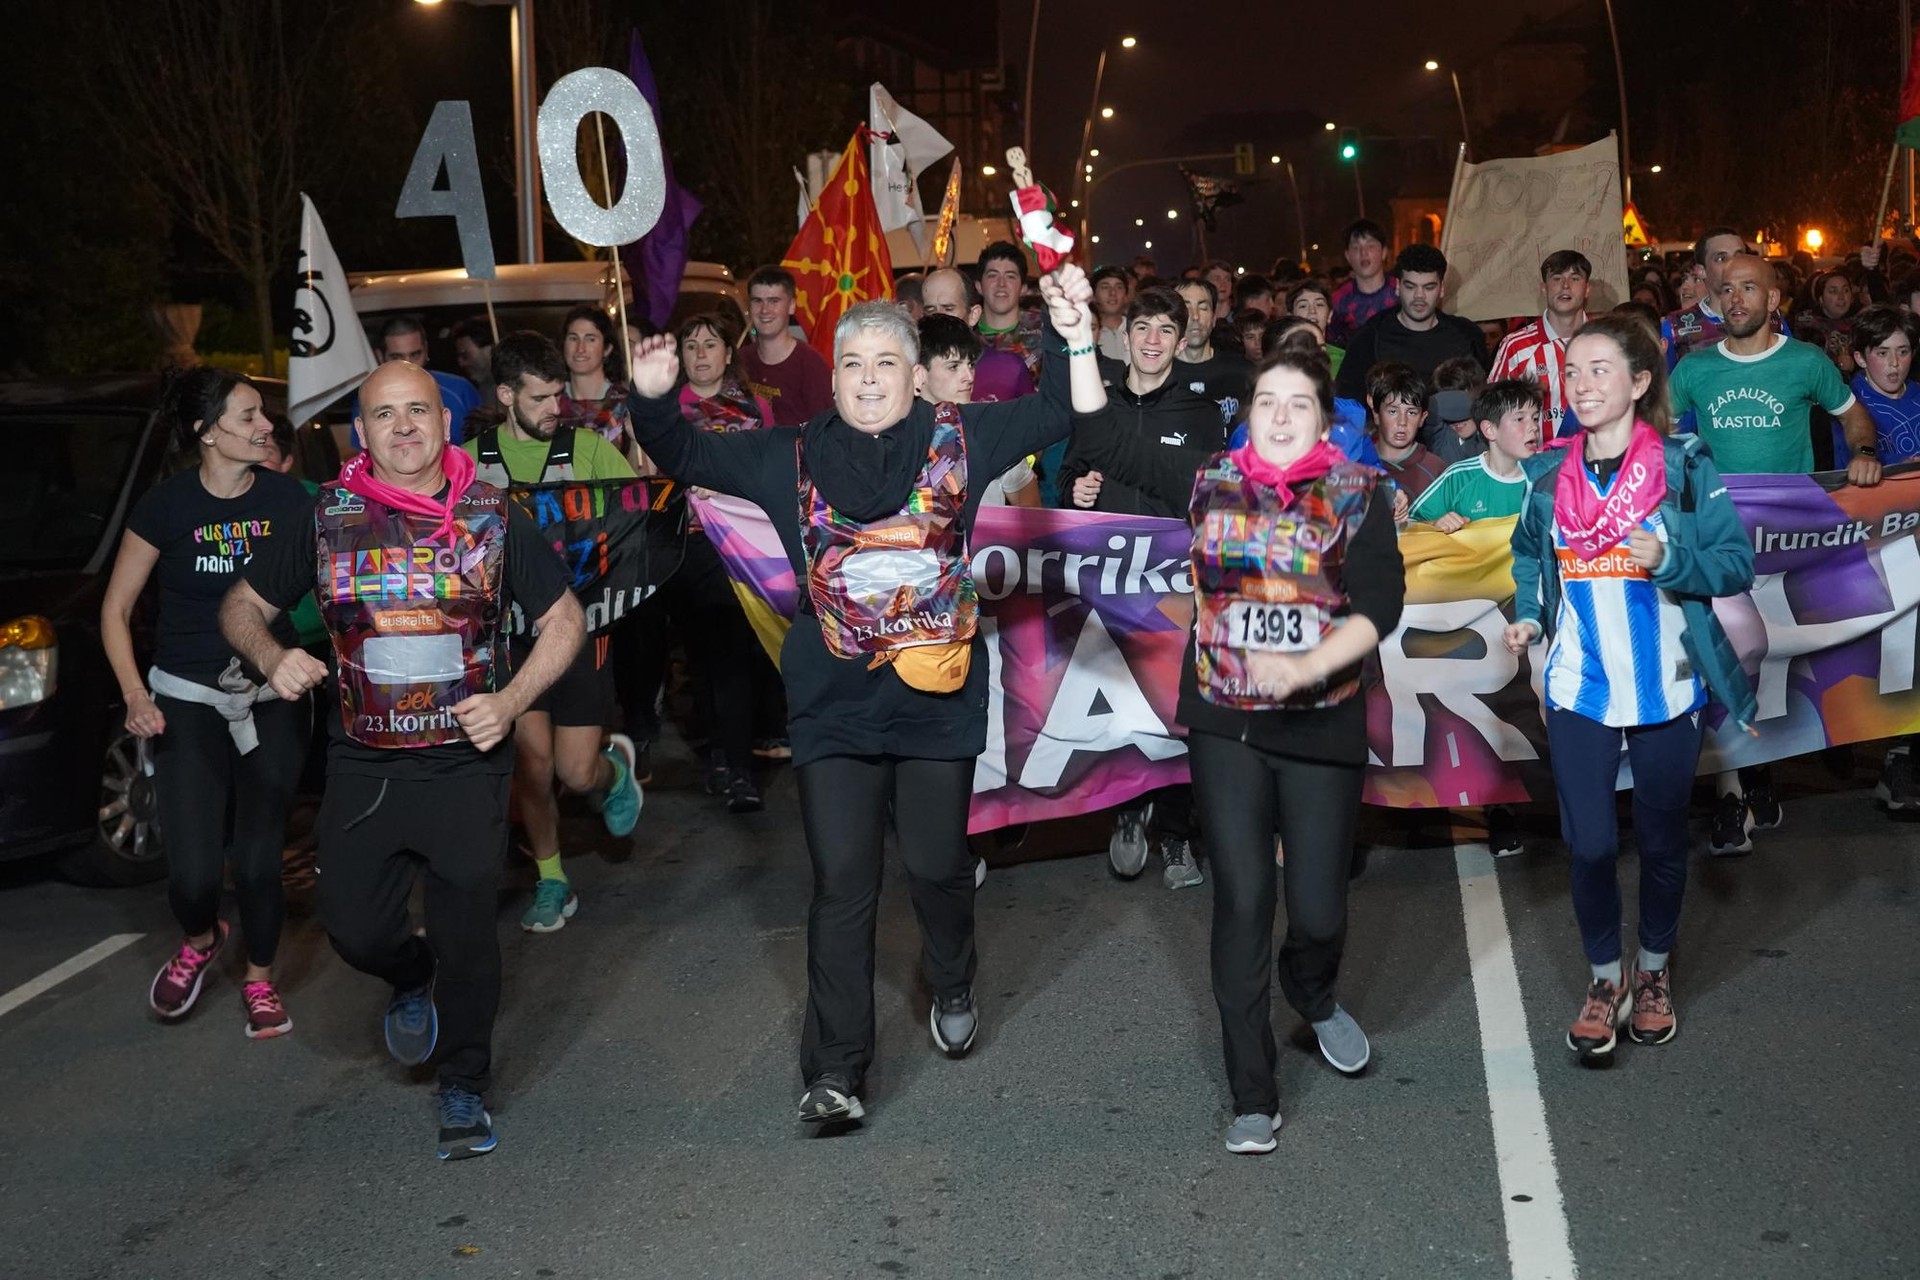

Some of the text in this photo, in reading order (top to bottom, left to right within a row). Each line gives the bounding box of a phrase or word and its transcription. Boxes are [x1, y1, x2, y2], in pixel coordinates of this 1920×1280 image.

[1707, 387, 1785, 416] ZARAUZKO
[1711, 415, 1781, 429] IKASTOLA
[1160, 436, 1182, 446] PUMA
[194, 520, 271, 543] euskaraz
[1583, 505, 1644, 551] JAIAK
[1755, 520, 1874, 554] Irundik
[219, 538, 250, 556] bizi
[195, 555, 234, 573] nahi
[331, 547, 460, 577] HARRO
[970, 535, 1195, 600] orrika
[380, 612, 437, 627] euskaltel
[1242, 605, 1303, 644] 1393
[396, 684, 438, 711] aek
[365, 705, 459, 733] 23.korrik
